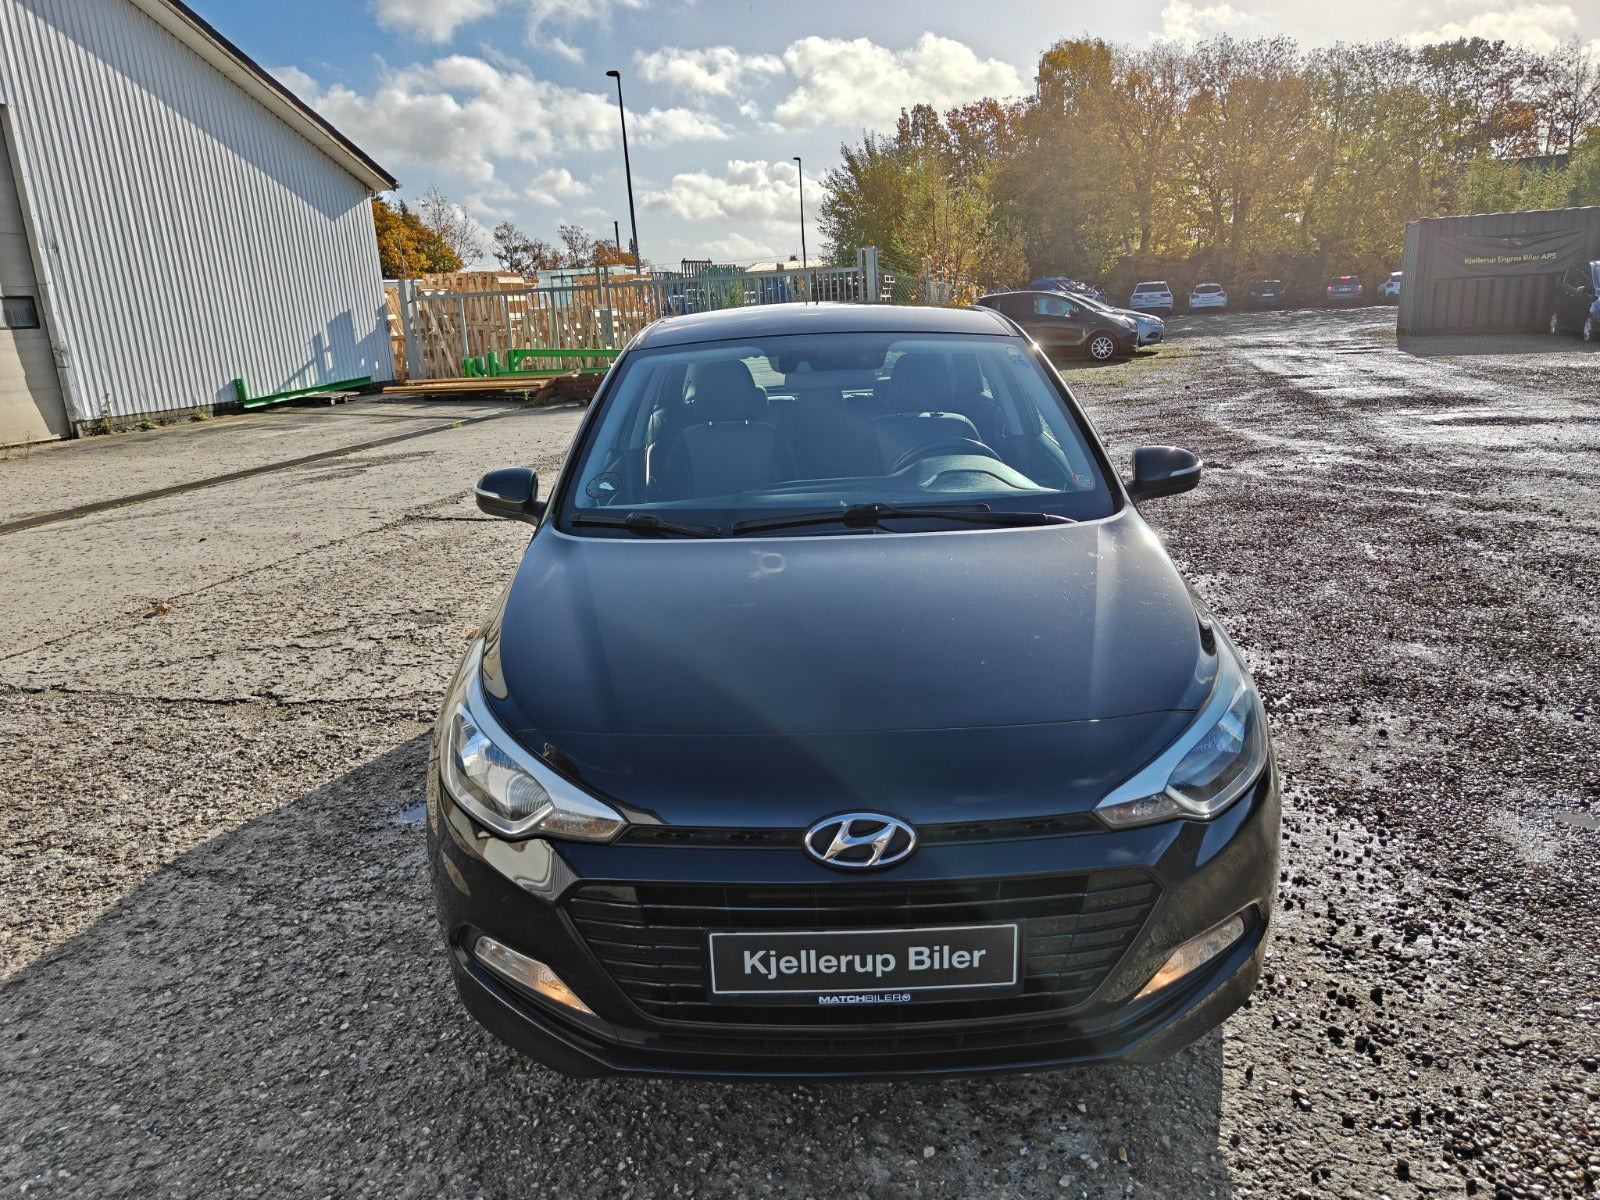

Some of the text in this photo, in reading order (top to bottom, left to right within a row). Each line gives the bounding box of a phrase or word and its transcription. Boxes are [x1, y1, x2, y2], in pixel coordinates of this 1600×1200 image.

[1465, 257, 1496, 265] Kjellerup
[1497, 255, 1522, 264] Engros
[1523, 253, 1540, 261] Biler
[743, 945, 987, 979] Kjellerup Biler
[818, 994, 902, 1004] MATCHBILER
